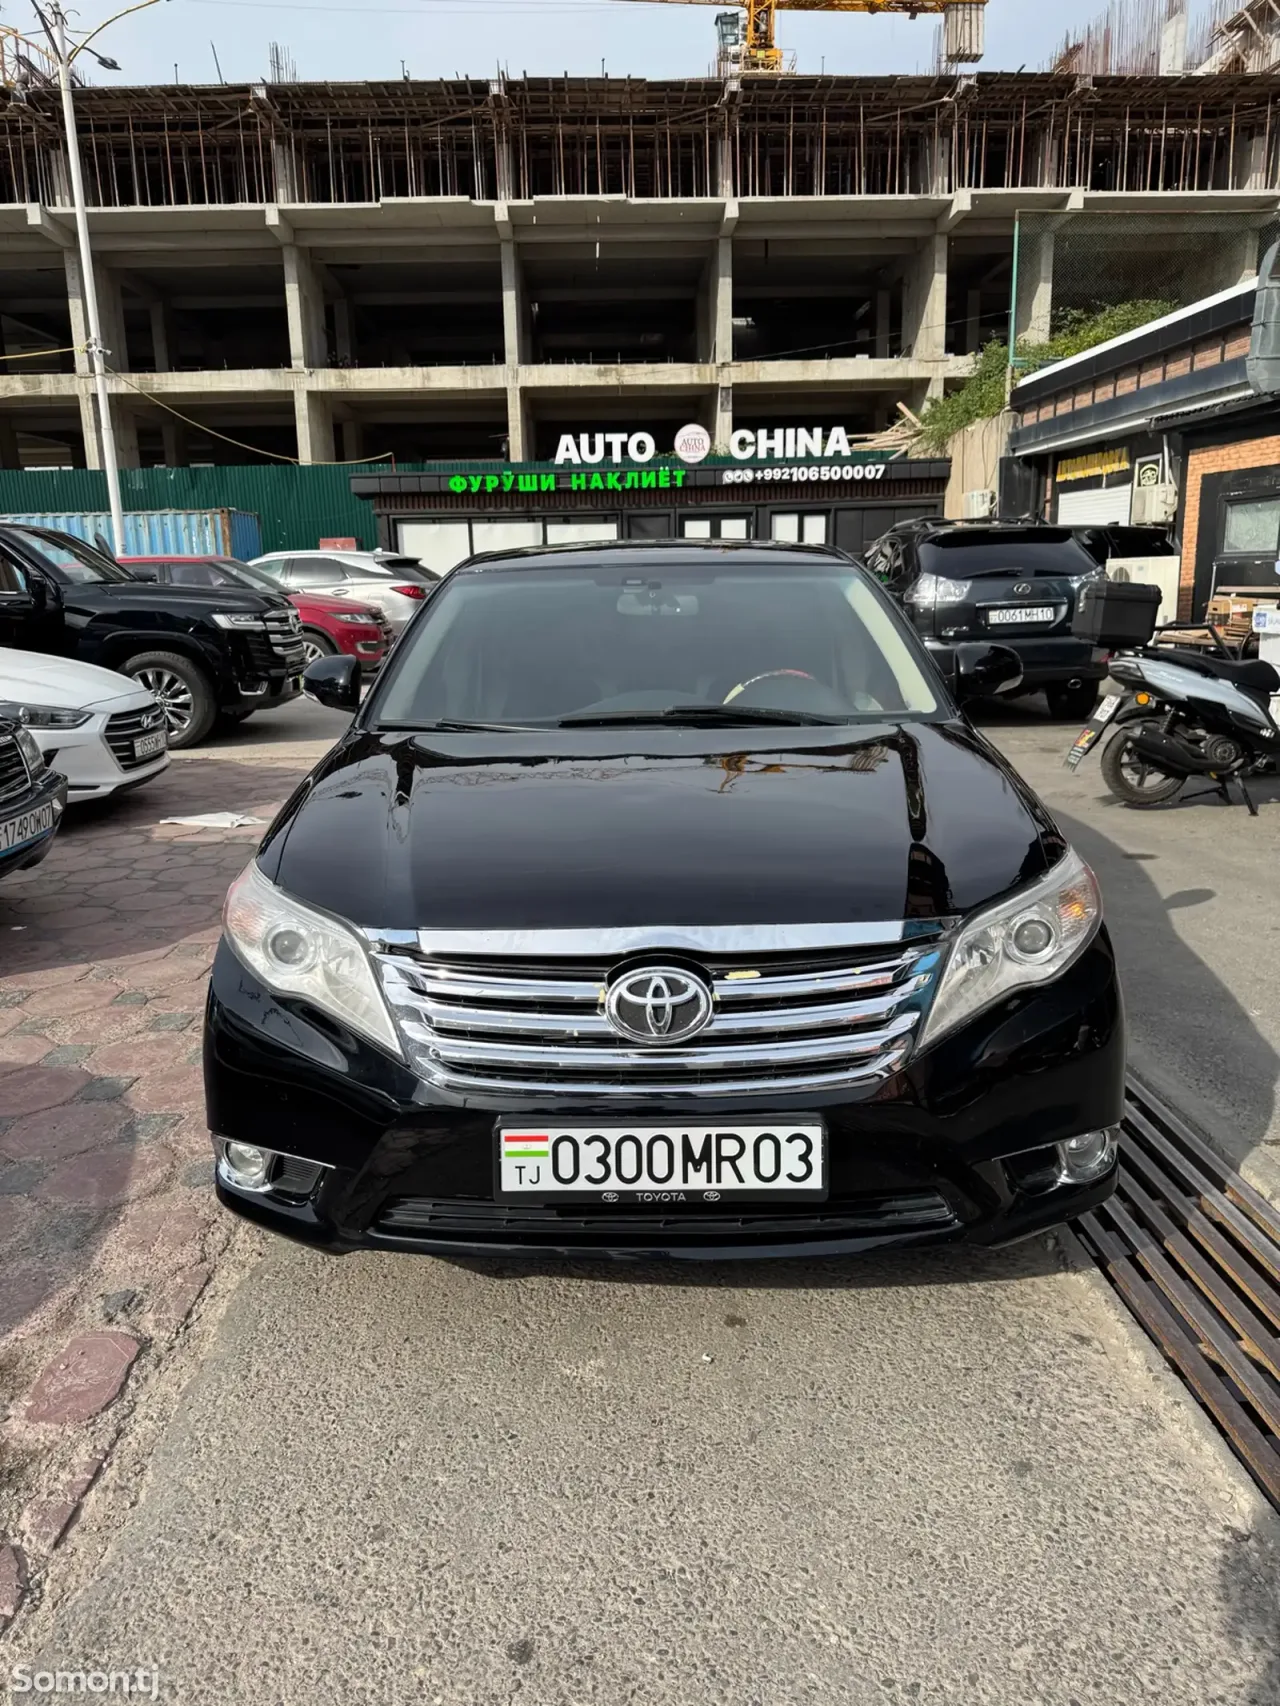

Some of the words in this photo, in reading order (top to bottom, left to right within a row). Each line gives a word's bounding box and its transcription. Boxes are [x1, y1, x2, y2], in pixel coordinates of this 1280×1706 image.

[554, 431, 656, 465] AUTO
[729, 426, 851, 460] CHINA
[681, 438, 704, 447] AUTO
[551, 1132, 813, 1185] 0300MR03
[515, 1166, 540, 1185] TJ
[636, 1192, 687, 1202] TOYOTA
